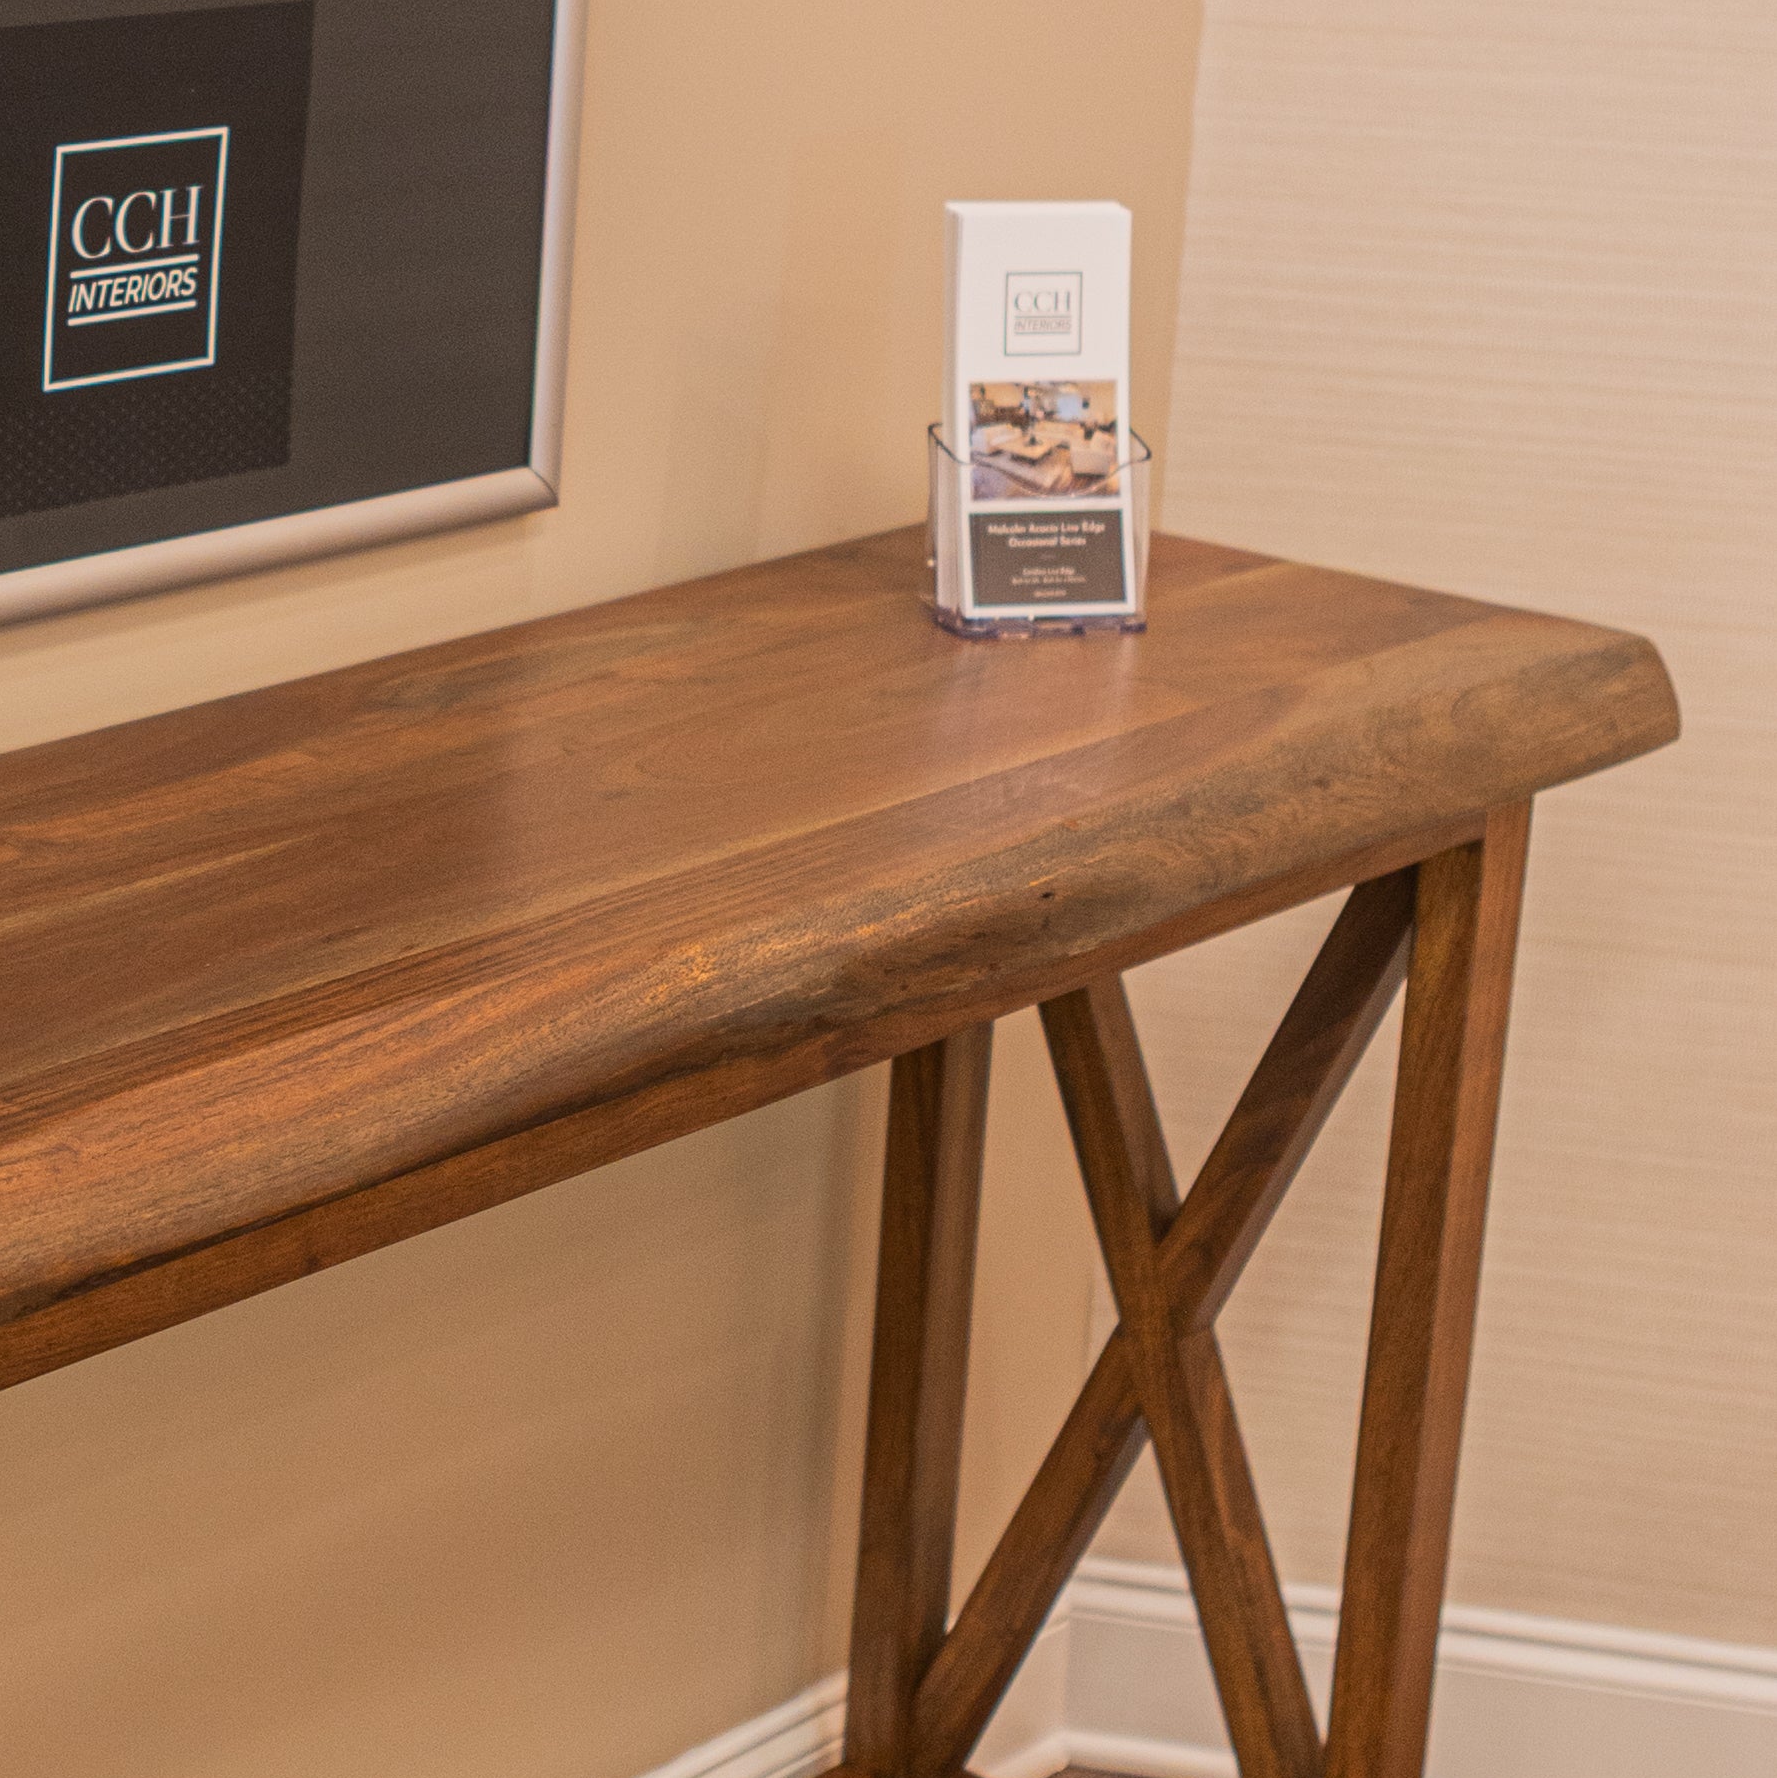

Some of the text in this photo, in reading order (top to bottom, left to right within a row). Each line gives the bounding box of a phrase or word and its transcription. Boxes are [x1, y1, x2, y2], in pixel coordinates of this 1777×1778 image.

[70, 185, 204, 259] CCH
[68, 266, 198, 313] INTERIORS
[1013, 290, 1071, 312] CCH
